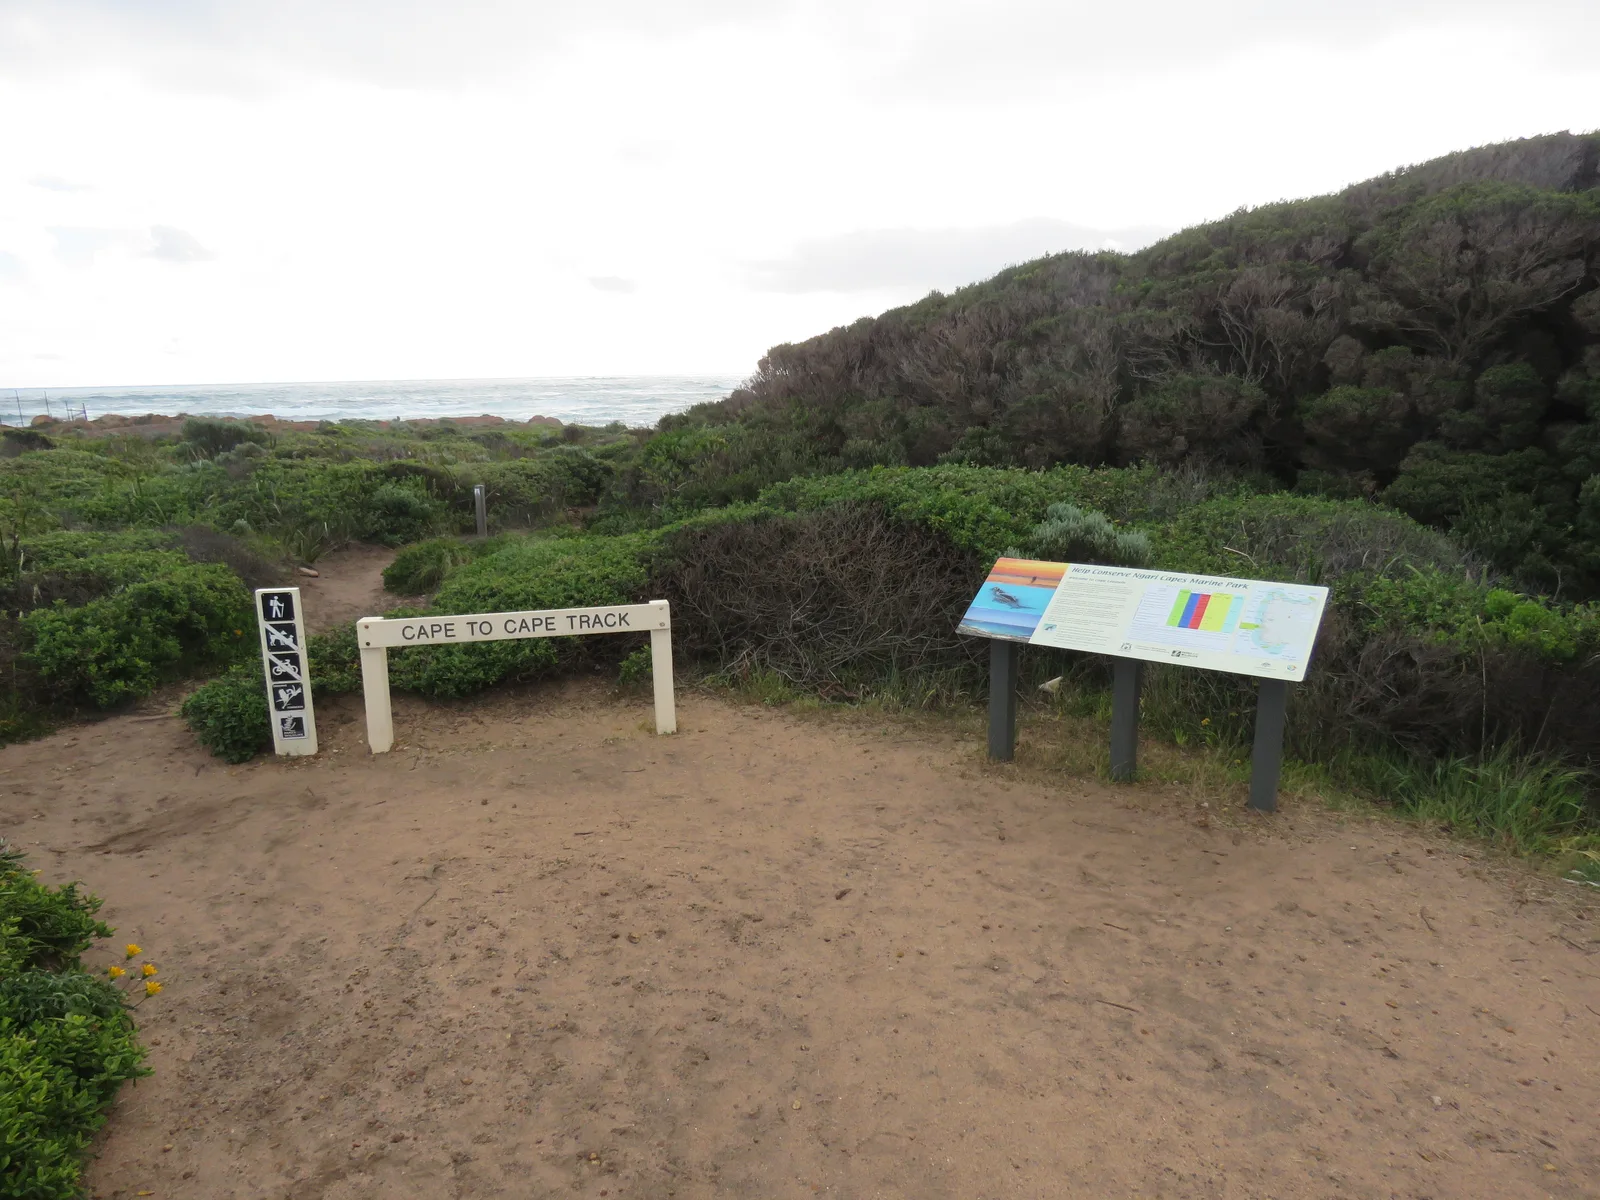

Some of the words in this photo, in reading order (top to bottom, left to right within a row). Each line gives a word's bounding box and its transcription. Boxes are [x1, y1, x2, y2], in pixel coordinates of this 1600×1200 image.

[1092, 568, 1131, 577] Conserve
[1132, 572, 1159, 580] Ngari
[1160, 575, 1187, 583] Capes
[1189, 578, 1224, 587] Marine
[1226, 581, 1250, 590] Park
[402, 622, 456, 641] CAPE
[466, 620, 493, 636] TO
[504, 616, 556, 634] CAPE
[566, 612, 630, 630] TRACK
